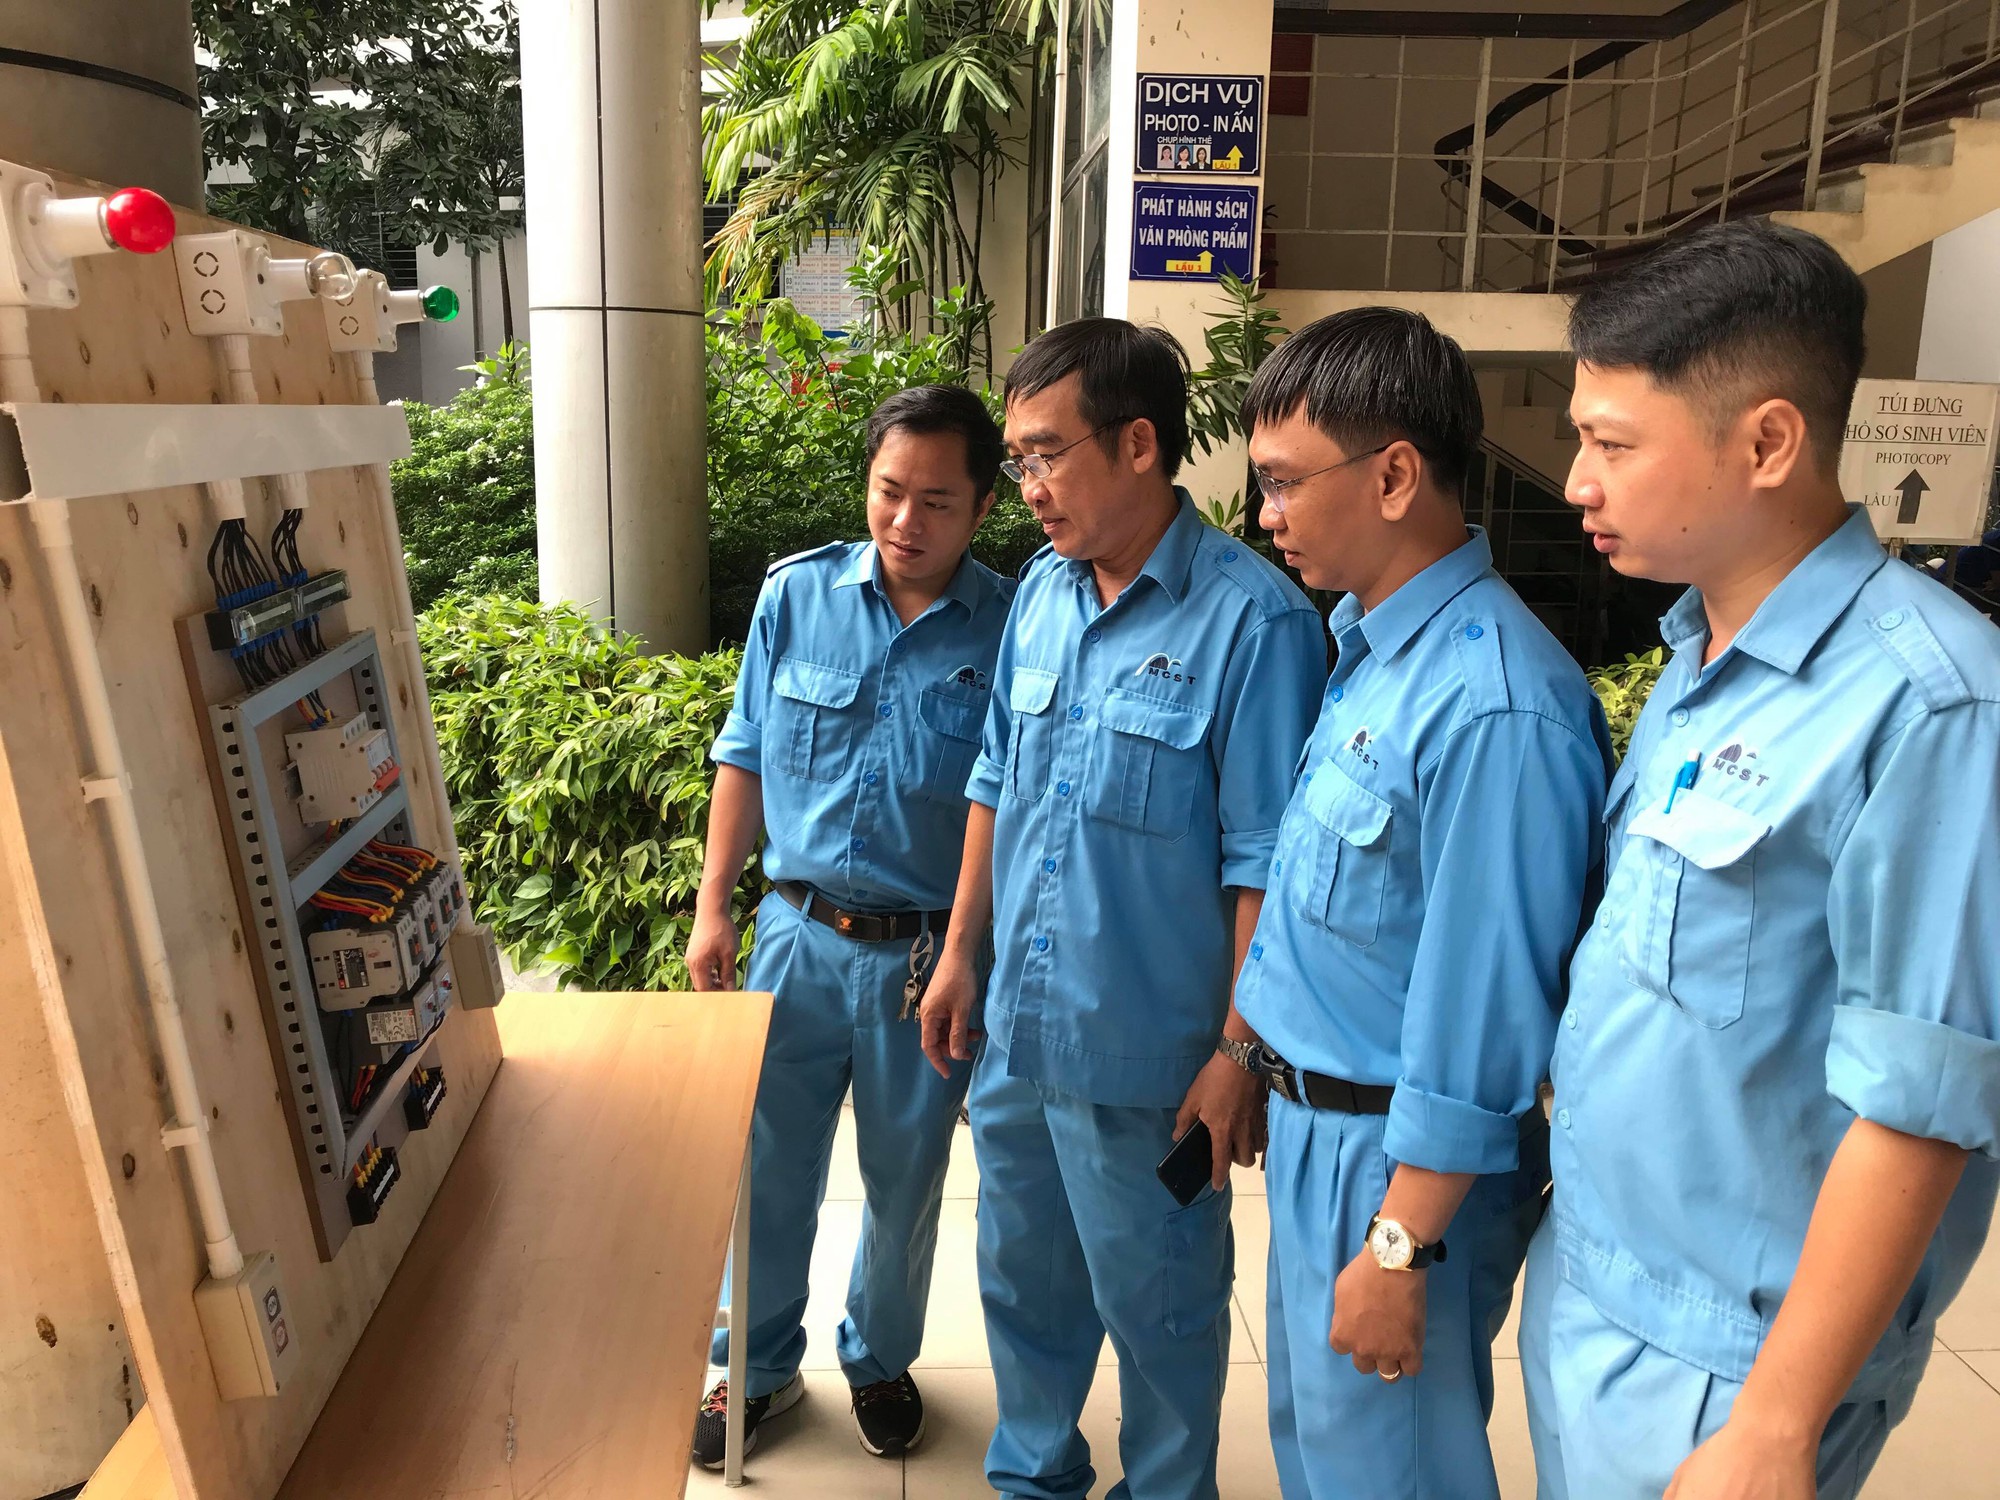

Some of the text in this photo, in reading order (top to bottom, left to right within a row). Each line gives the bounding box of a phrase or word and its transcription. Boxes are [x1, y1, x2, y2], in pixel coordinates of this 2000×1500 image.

[1145, 82, 1253, 109] DỊCH VỤ
[1144, 114, 1200, 132] PHOTO
[1213, 115, 1229, 133] IN
[1230, 110, 1254, 133] ẤN
[1141, 193, 1248, 219] PHÁT HÀNH SÁCH
[1139, 222, 1248, 249] VĂN PHÒNG PHẨM
[1878, 392, 1963, 415] TÚI ĐỰNG
[1846, 419, 1988, 443] HỒ SƠ SINH VIÊN
[1875, 452, 1951, 465] PHOTOCOPY
[957, 676, 986, 690] MCS
[1148, 667, 1196, 685] MCST
[1351, 742, 1379, 771] MCST
[1712, 758, 1770, 787] MCST
